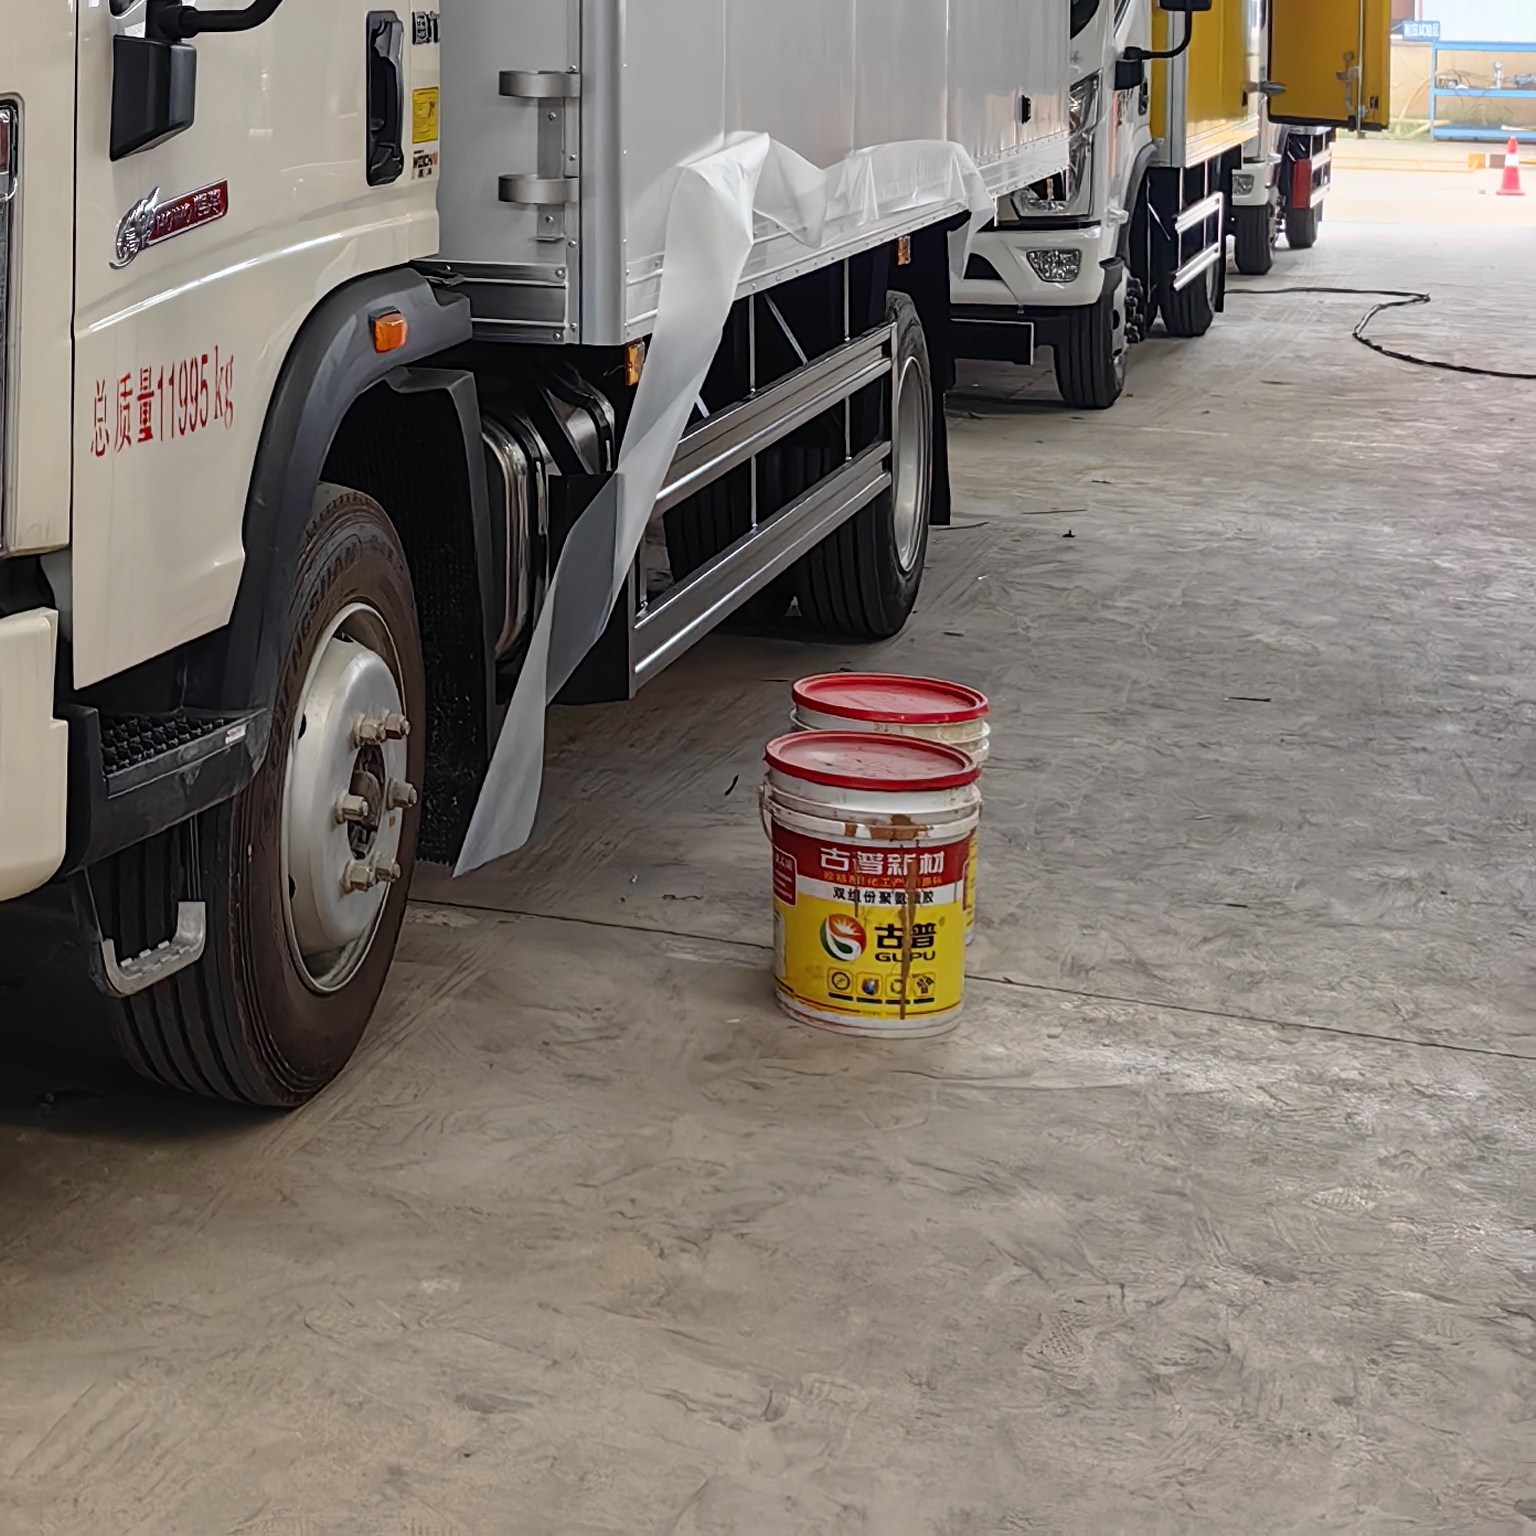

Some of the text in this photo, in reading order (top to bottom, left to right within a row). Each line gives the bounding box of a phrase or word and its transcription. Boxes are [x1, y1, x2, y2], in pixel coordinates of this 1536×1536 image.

[820, 846, 945, 876] 古普新材
[874, 922, 937, 949] 古普
